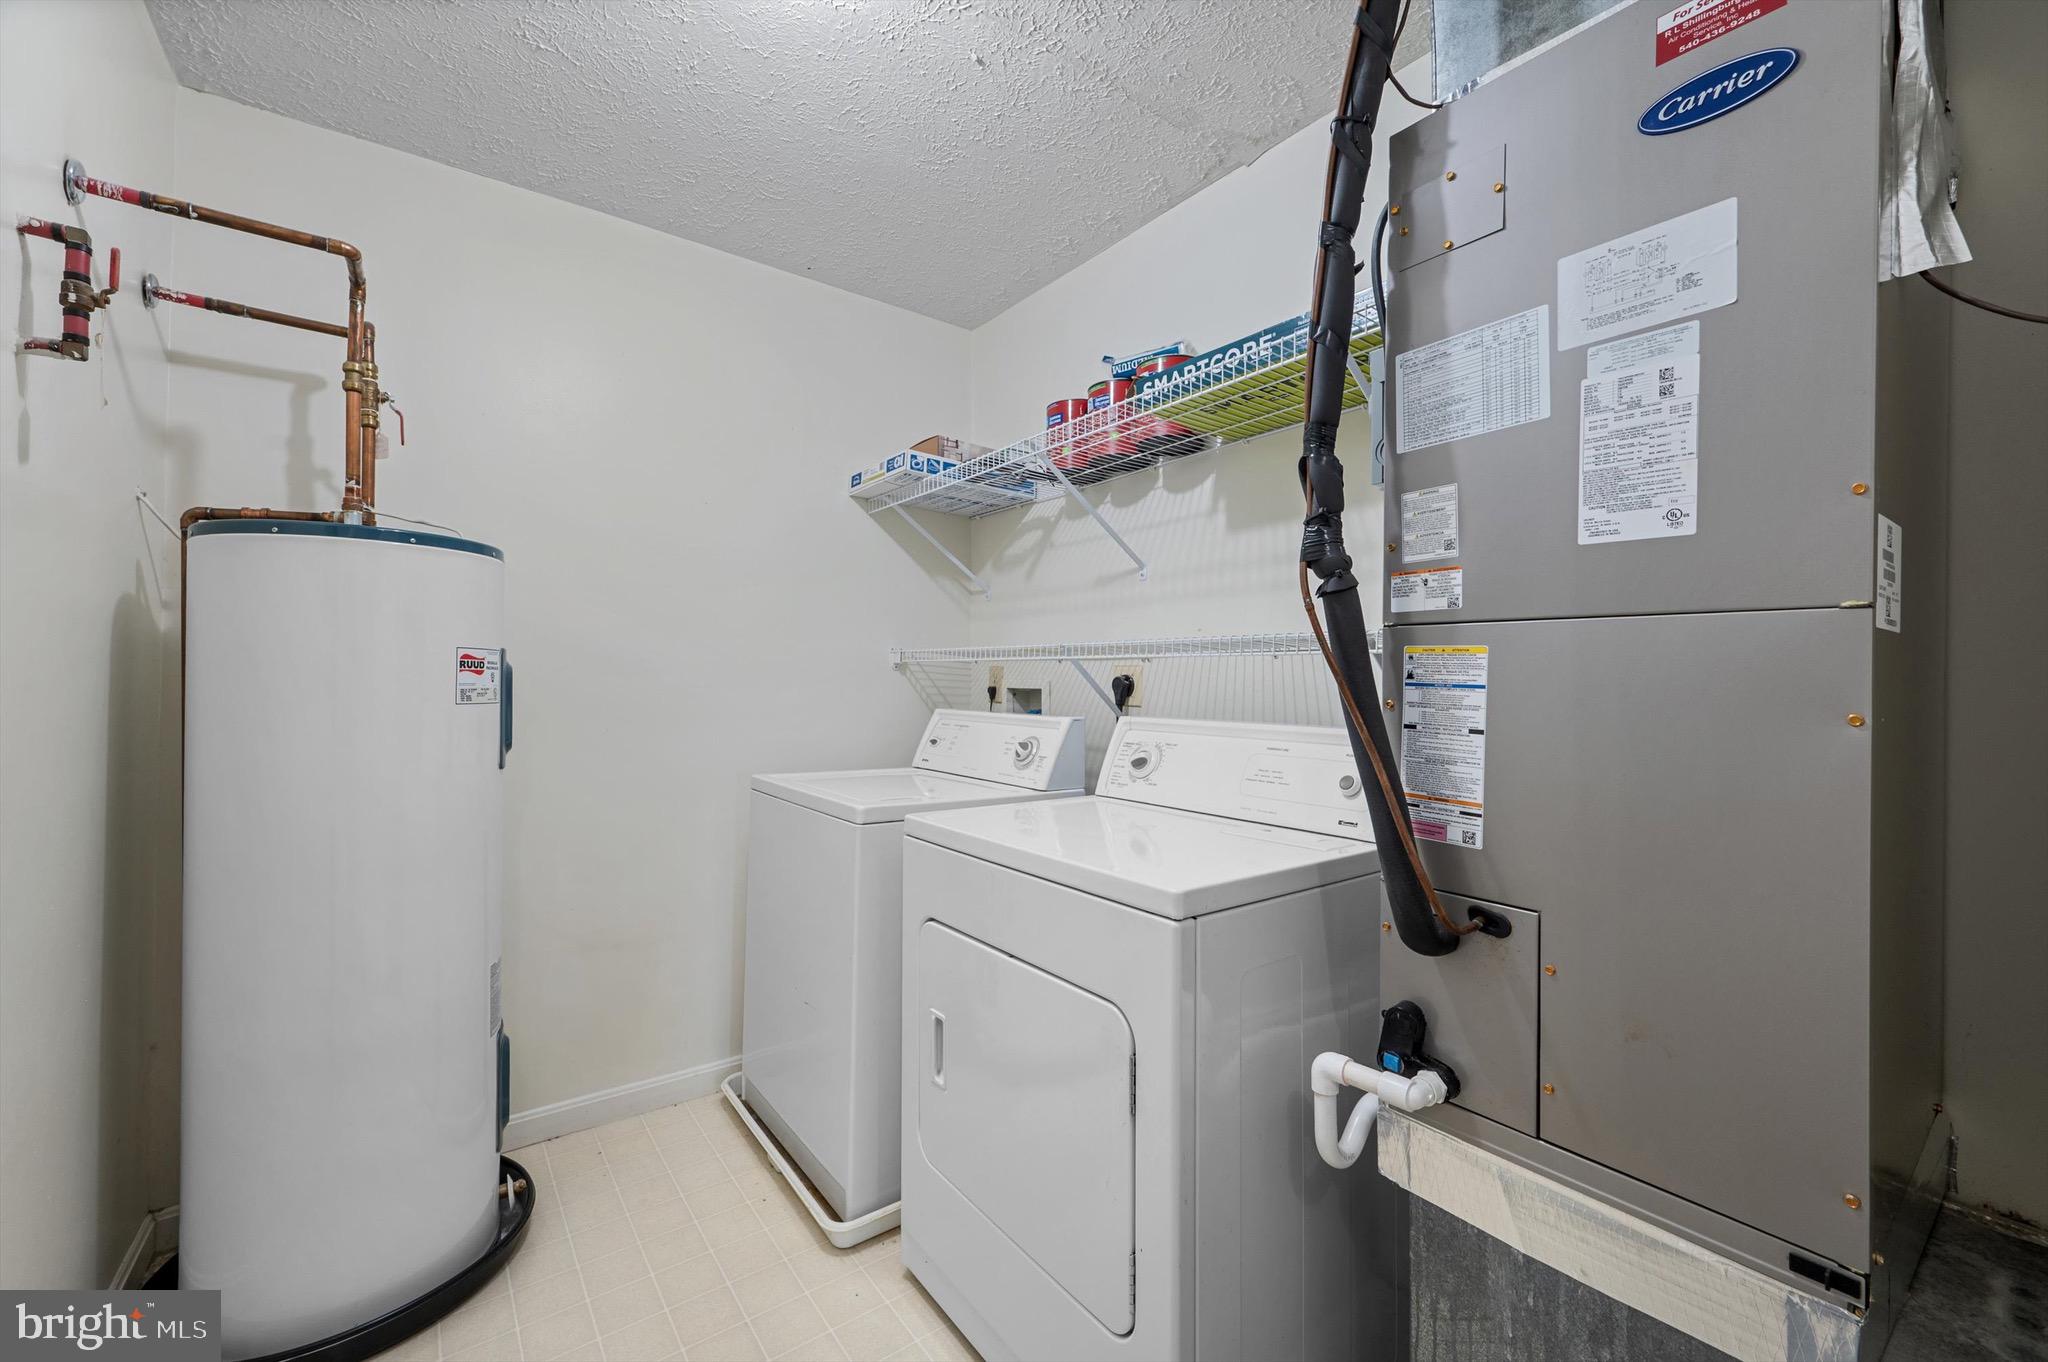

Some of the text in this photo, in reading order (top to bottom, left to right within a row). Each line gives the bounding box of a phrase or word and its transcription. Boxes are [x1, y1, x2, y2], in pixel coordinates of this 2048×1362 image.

[1672, 6, 1694, 22] For
[1664, 30, 1672, 38] R
[1674, 26, 1681, 34] L
[1658, 61, 1773, 121] Carrier
[1143, 333, 1272, 399] SMARTCORE
[459, 660, 485, 669] RUUD
